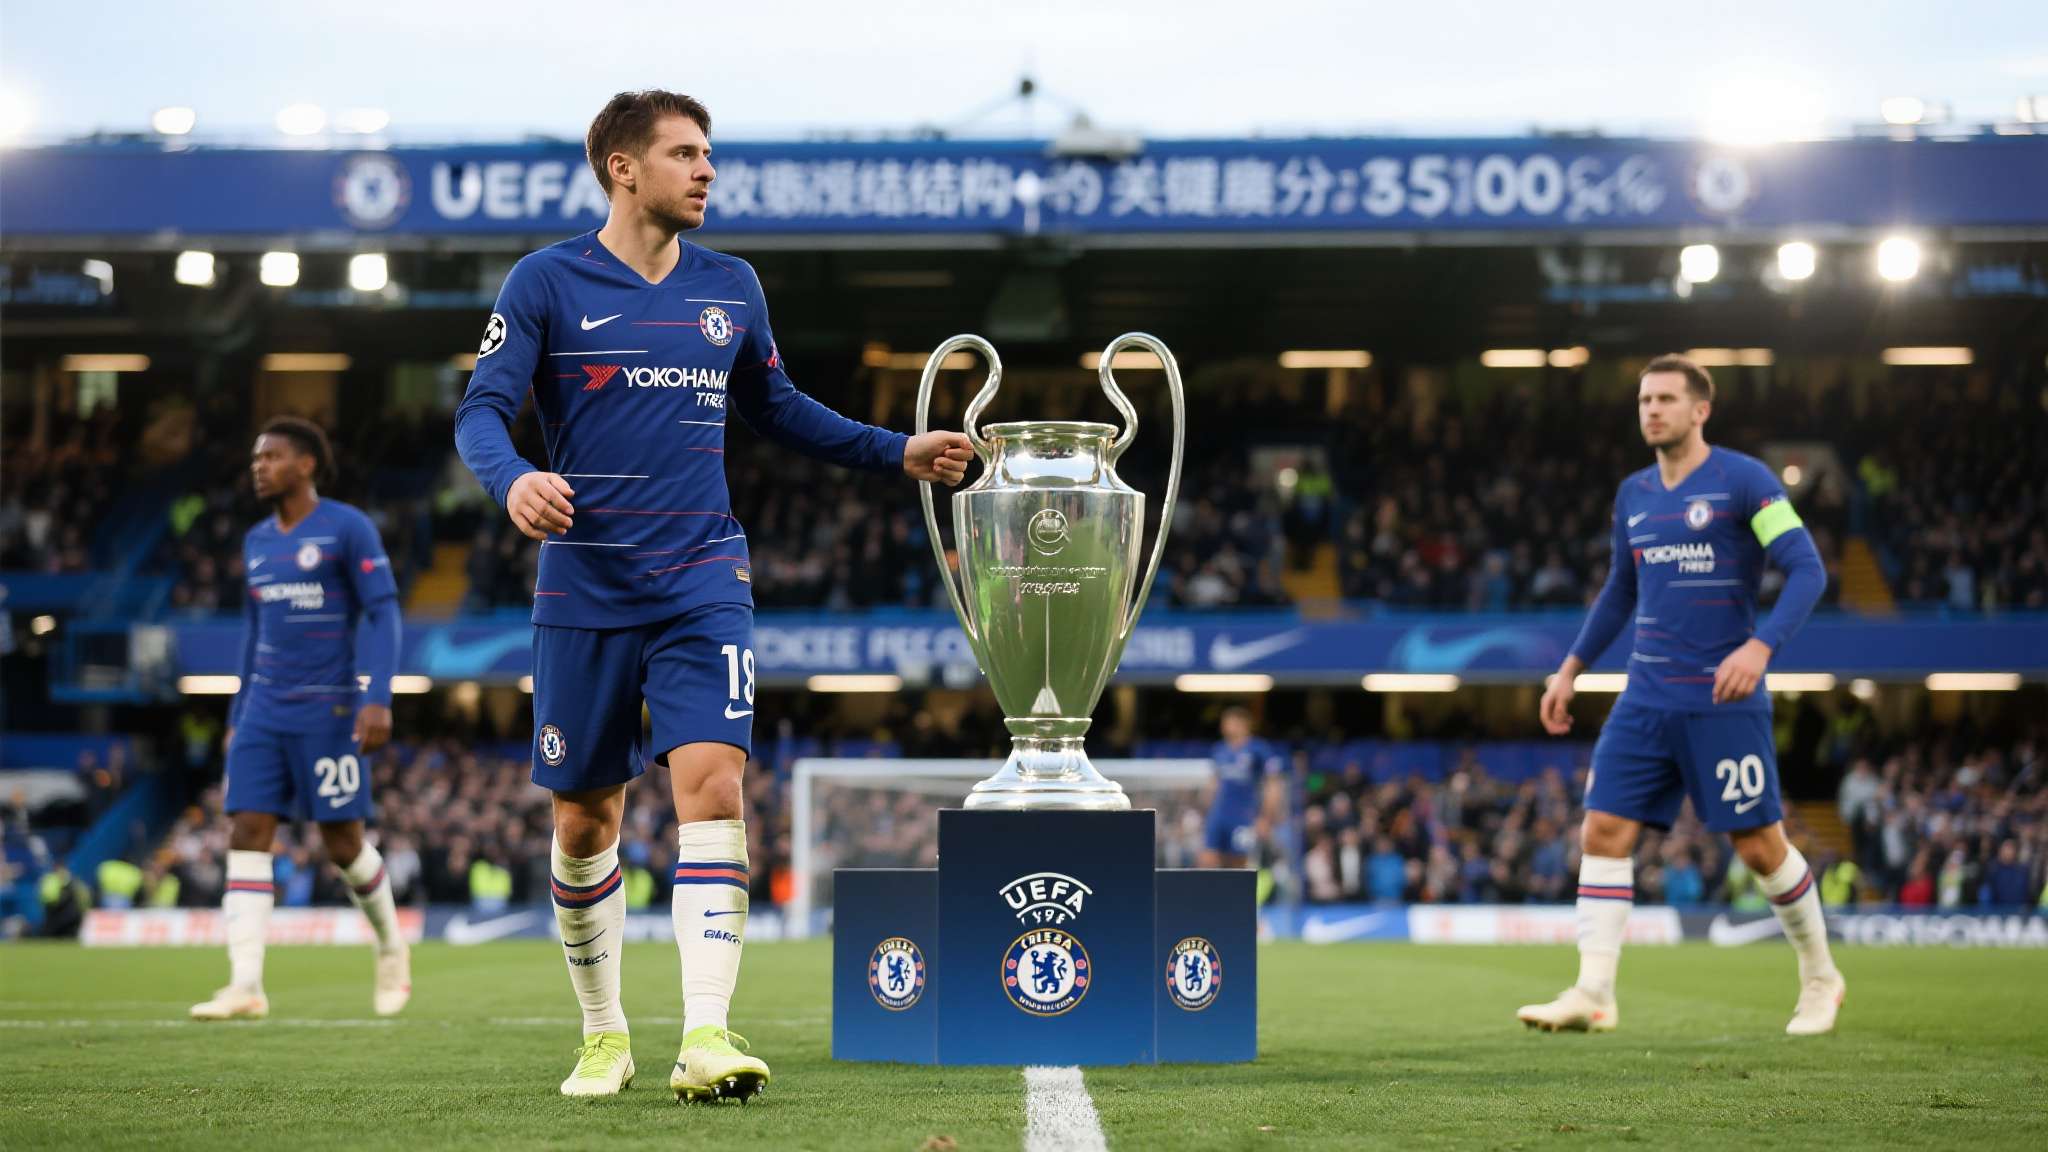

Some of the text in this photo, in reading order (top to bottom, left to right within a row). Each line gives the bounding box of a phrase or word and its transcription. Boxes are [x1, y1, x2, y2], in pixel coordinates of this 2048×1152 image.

[431, 160, 612, 220] UEFA
[721, 644, 755, 706] 18
[314, 754, 361, 798] 20
[1716, 754, 1766, 801] 20
[1004, 879, 1084, 913] UEFA
